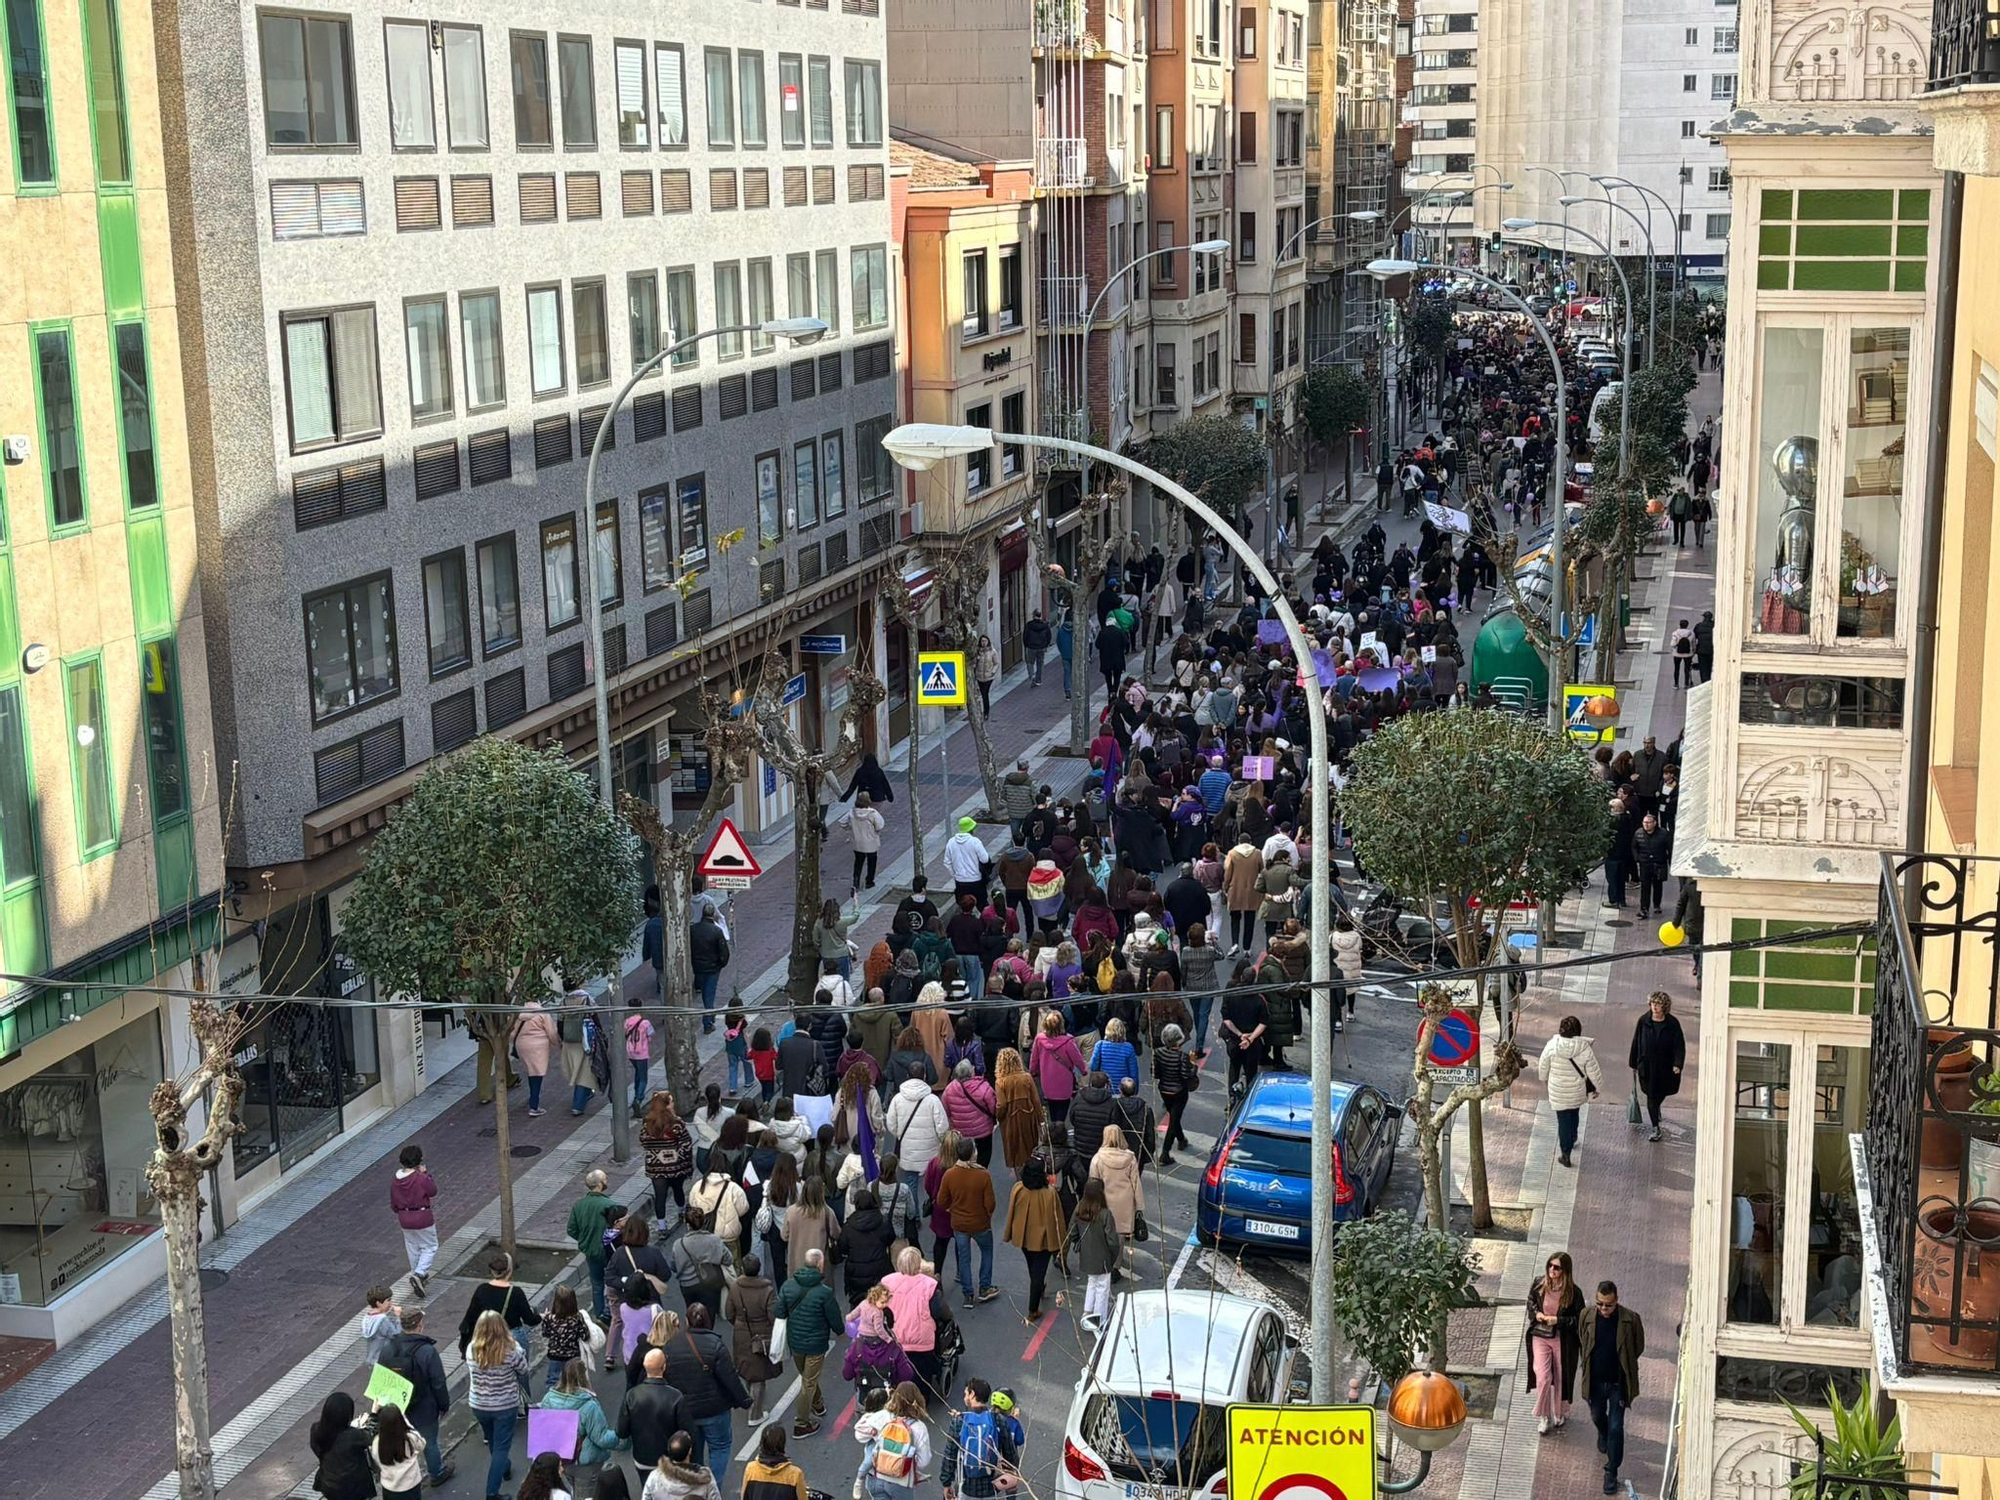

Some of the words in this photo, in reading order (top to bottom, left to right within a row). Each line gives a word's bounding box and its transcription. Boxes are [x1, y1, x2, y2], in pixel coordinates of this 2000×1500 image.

[1253, 1222, 1276, 1234] 3104
[1278, 1225, 1296, 1237] GSH
[1239, 1425, 1365, 1447] ATENCIÓN
